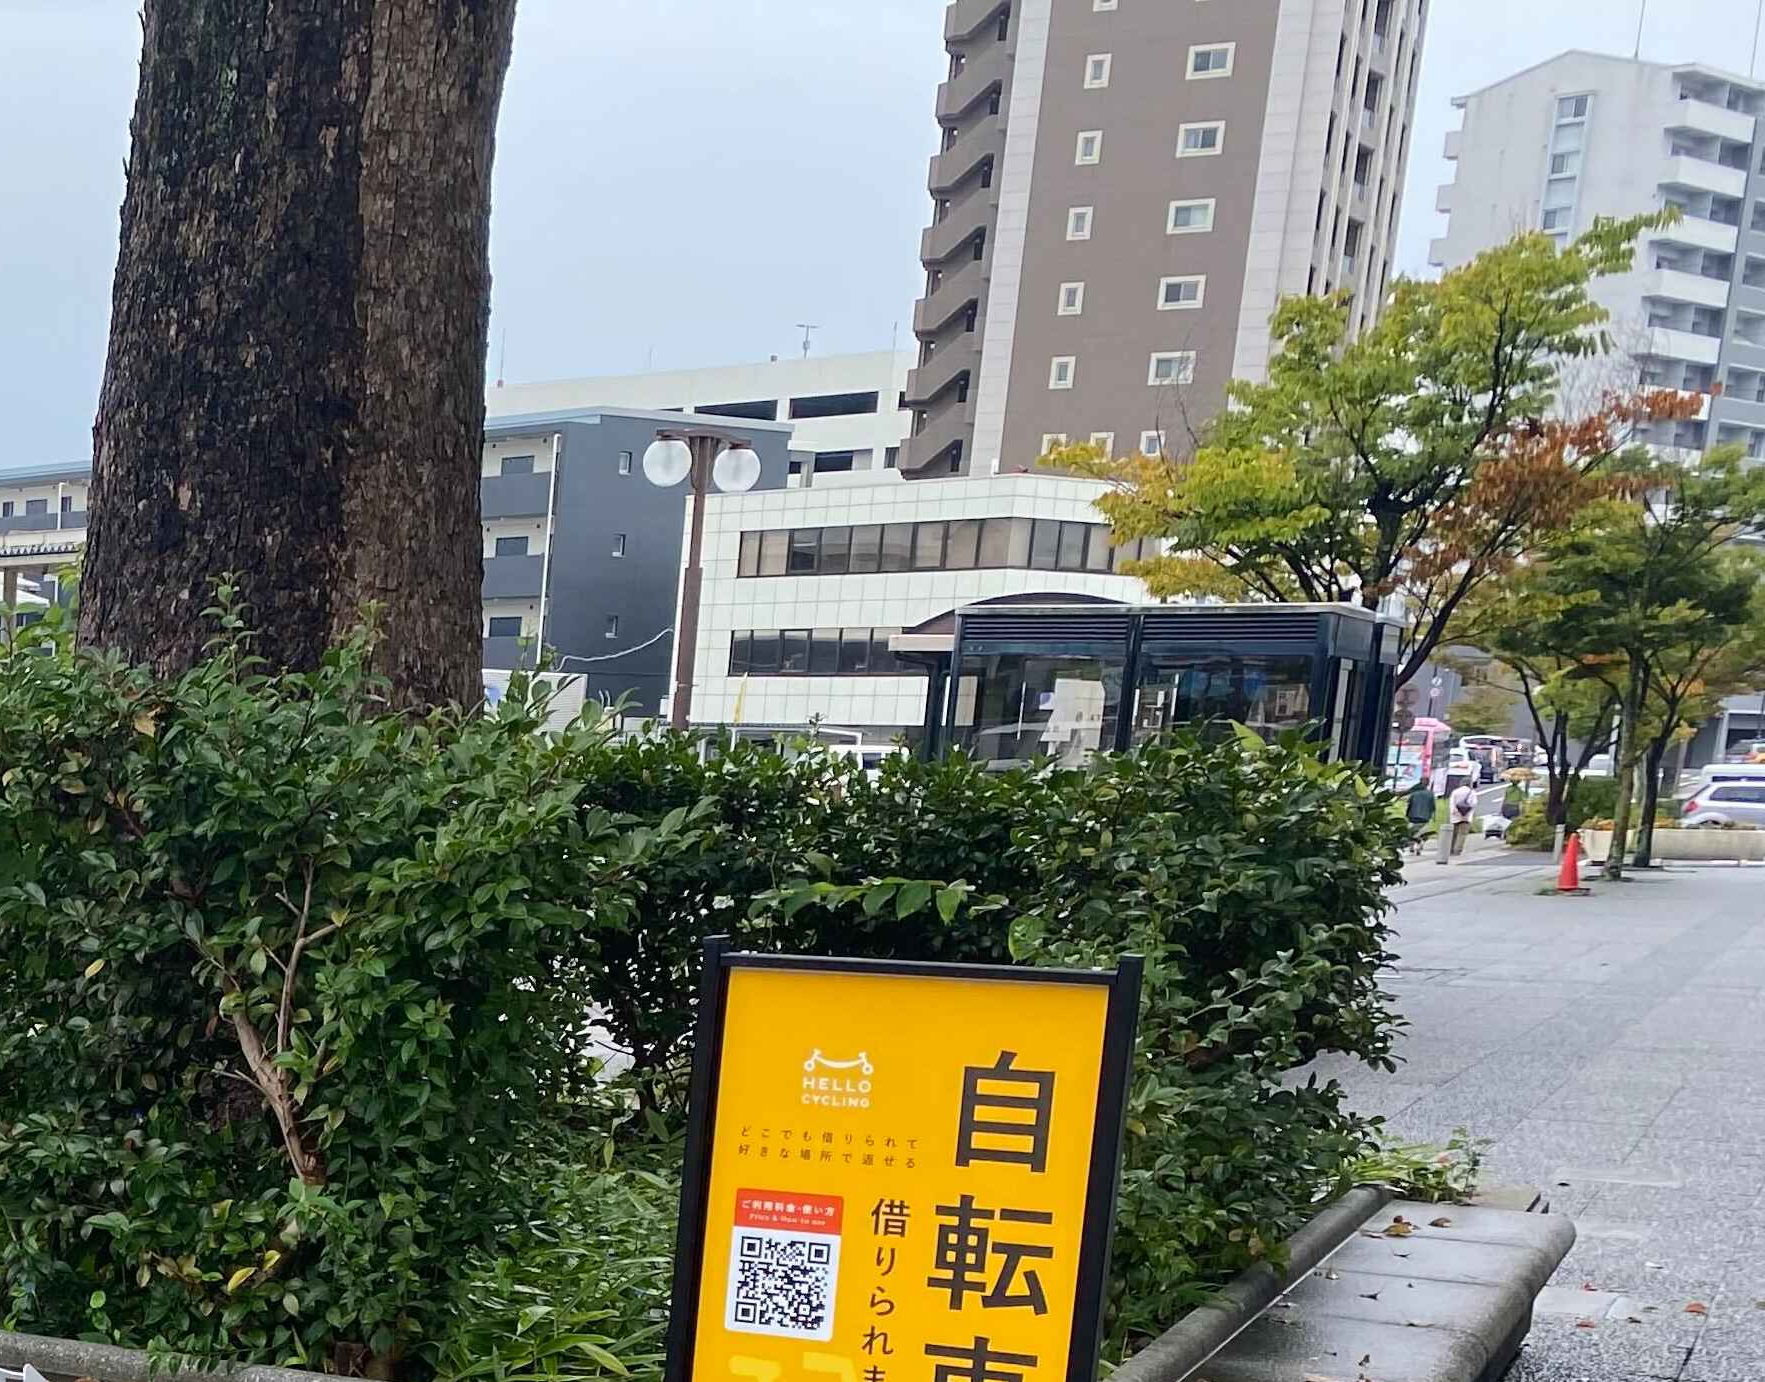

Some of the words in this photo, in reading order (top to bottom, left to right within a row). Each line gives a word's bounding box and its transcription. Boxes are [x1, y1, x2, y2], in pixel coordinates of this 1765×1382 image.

[802, 1077, 872, 1093] HELLO
[801, 1093, 871, 1108] CYCLING
[740, 1125, 919, 1150] どこでも借りられて
[738, 1144, 916, 1169] 好きな場所で返せる
